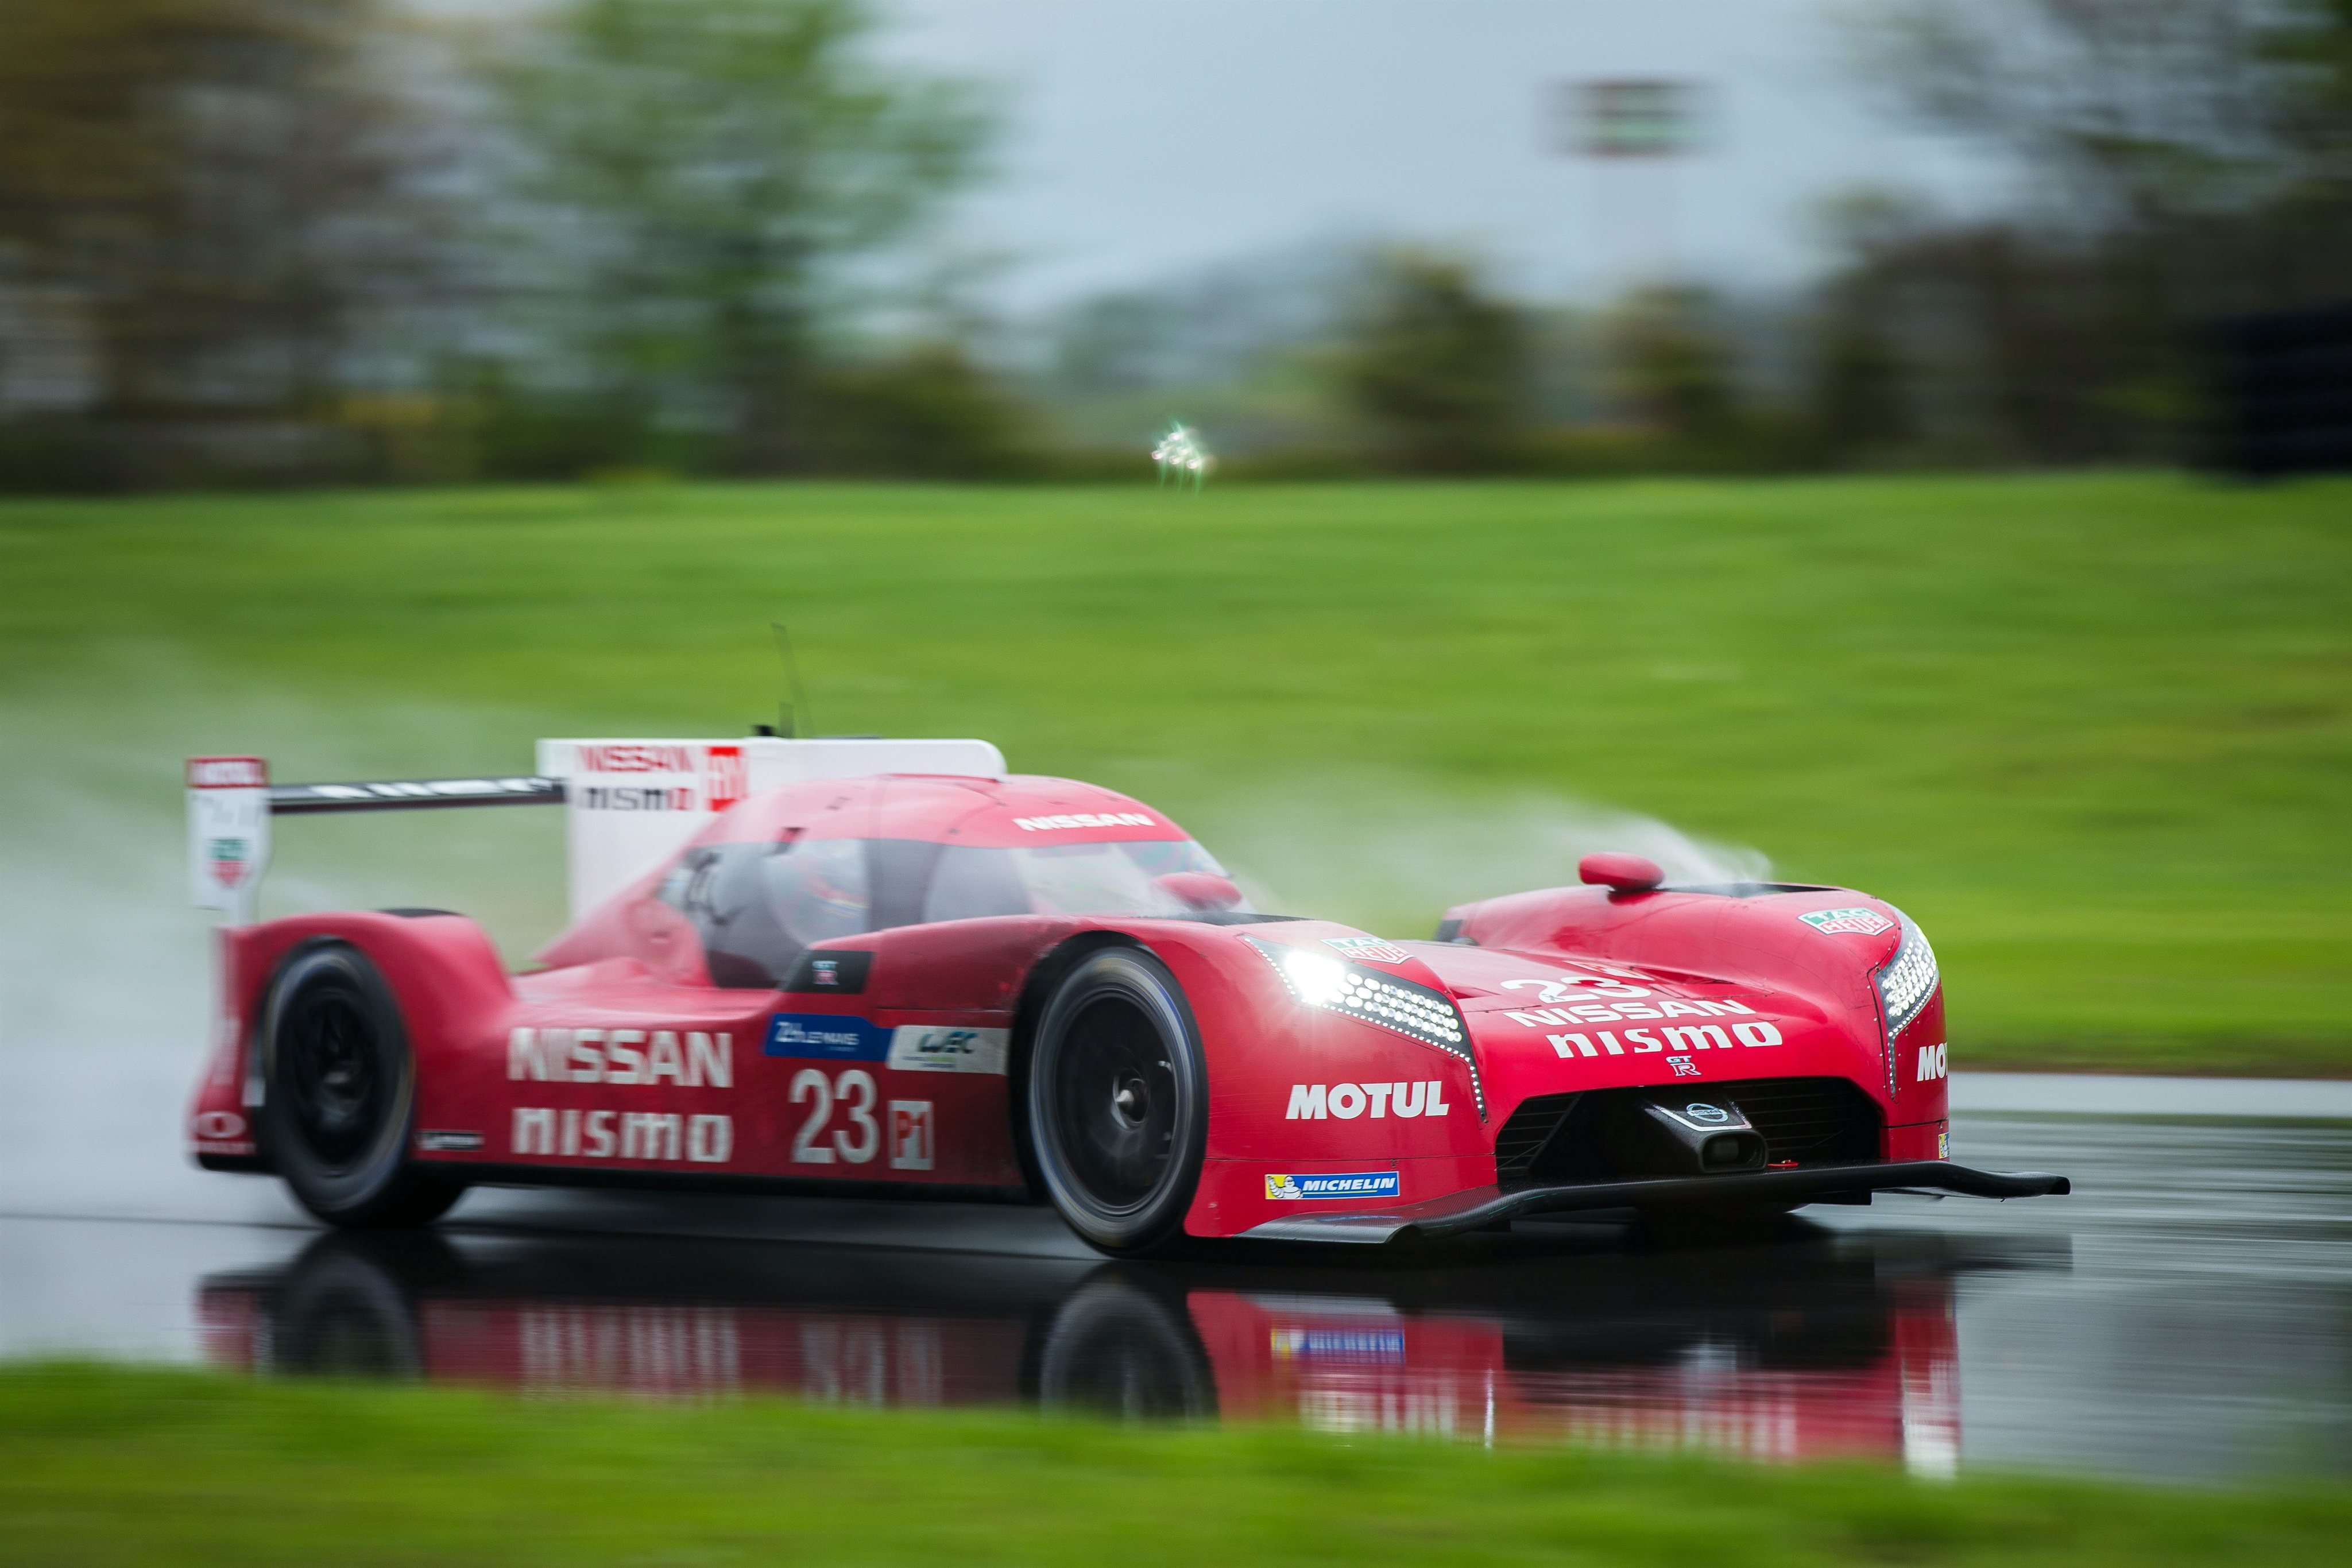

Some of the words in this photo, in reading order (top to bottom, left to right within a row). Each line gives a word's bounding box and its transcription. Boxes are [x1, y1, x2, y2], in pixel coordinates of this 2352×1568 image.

[1012, 813, 1156, 831] NISSAN
[1808, 909, 1873, 921] TAG
[1500, 977, 1651, 1003] 23
[1503, 1000, 1757, 1027] NISSAN
[507, 1027, 733, 1087] NISSAN
[1666, 1055, 1692, 1063] GT
[1670, 1063, 1702, 1077] R
[1917, 1042, 1947, 1082] MO
[1285, 1081, 1450, 1120] MOTUL
[788, 1069, 880, 1164] 23
[1302, 1177, 1396, 1191] MICHELIN
